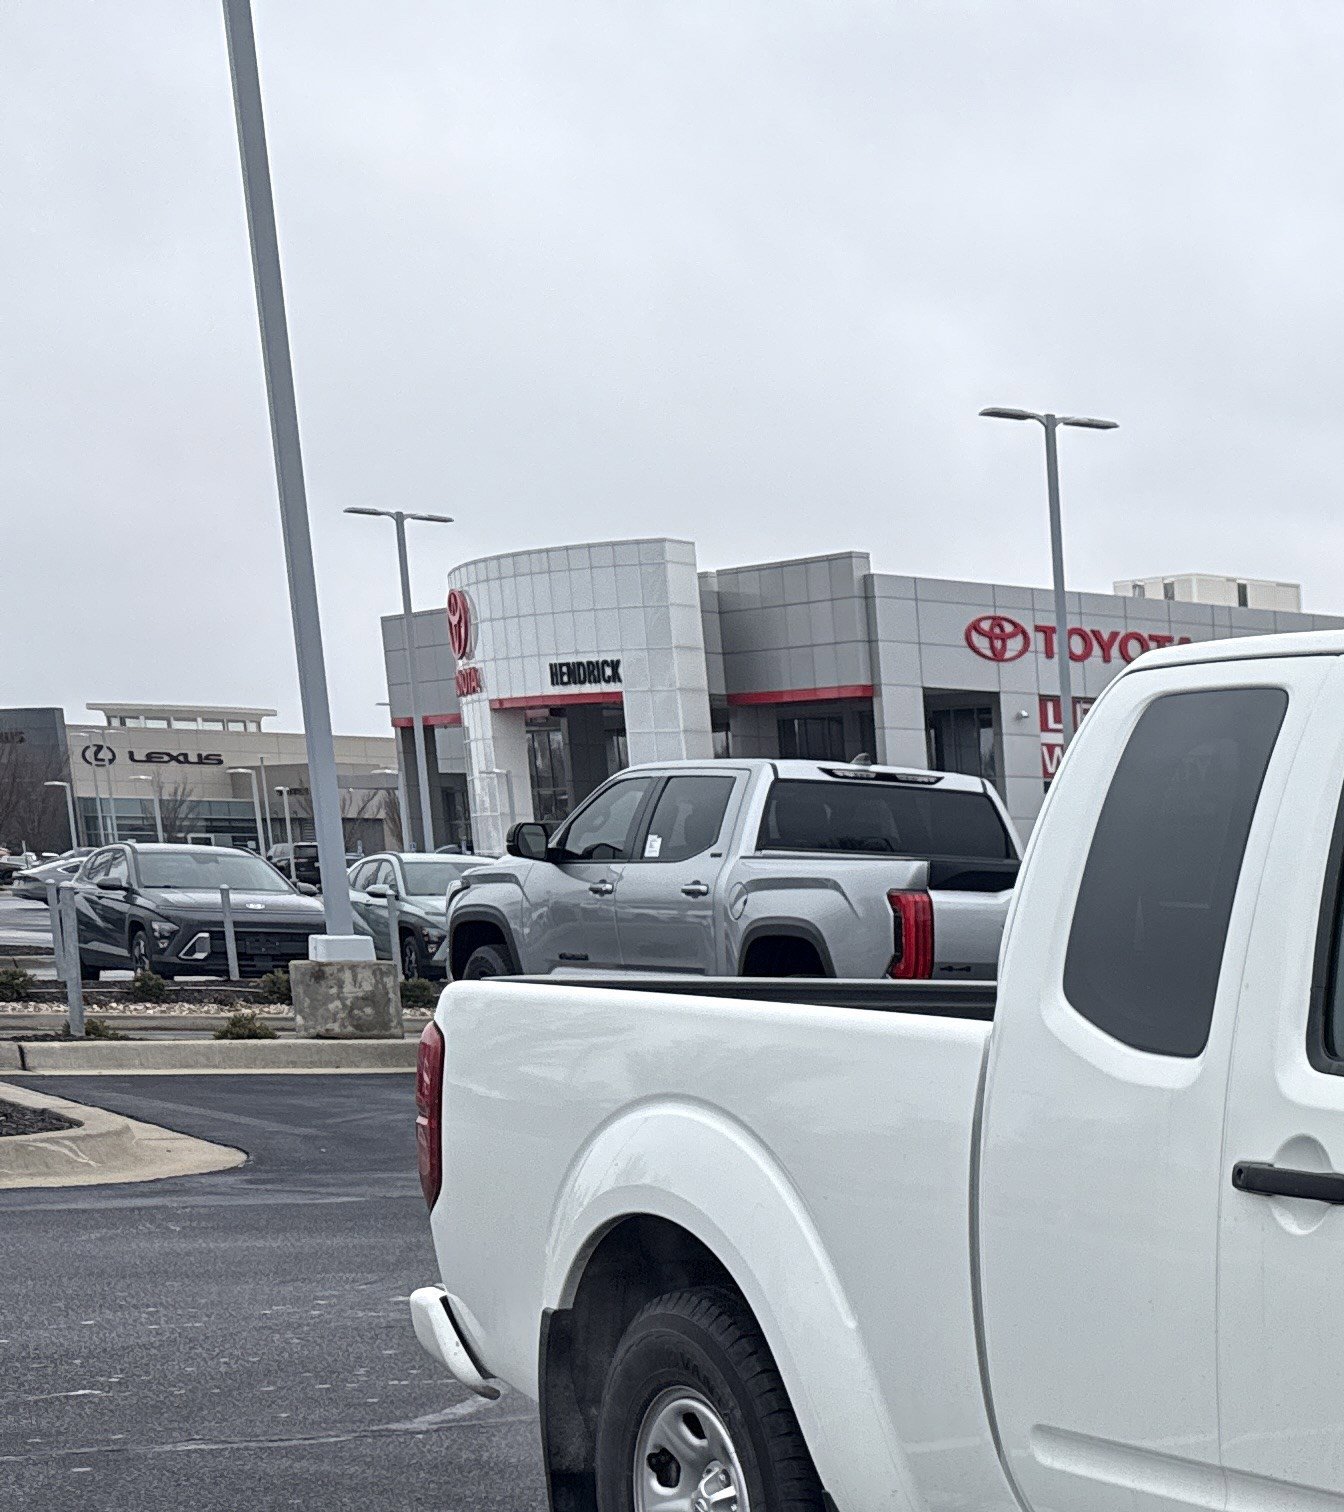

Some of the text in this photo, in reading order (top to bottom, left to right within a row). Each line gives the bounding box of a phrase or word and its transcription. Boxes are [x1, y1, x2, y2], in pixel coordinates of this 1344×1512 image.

[1034, 624, 1192, 664] TOYOT
[548, 658, 622, 687] HENDRICK
[128, 750, 224, 766] LEXUS
